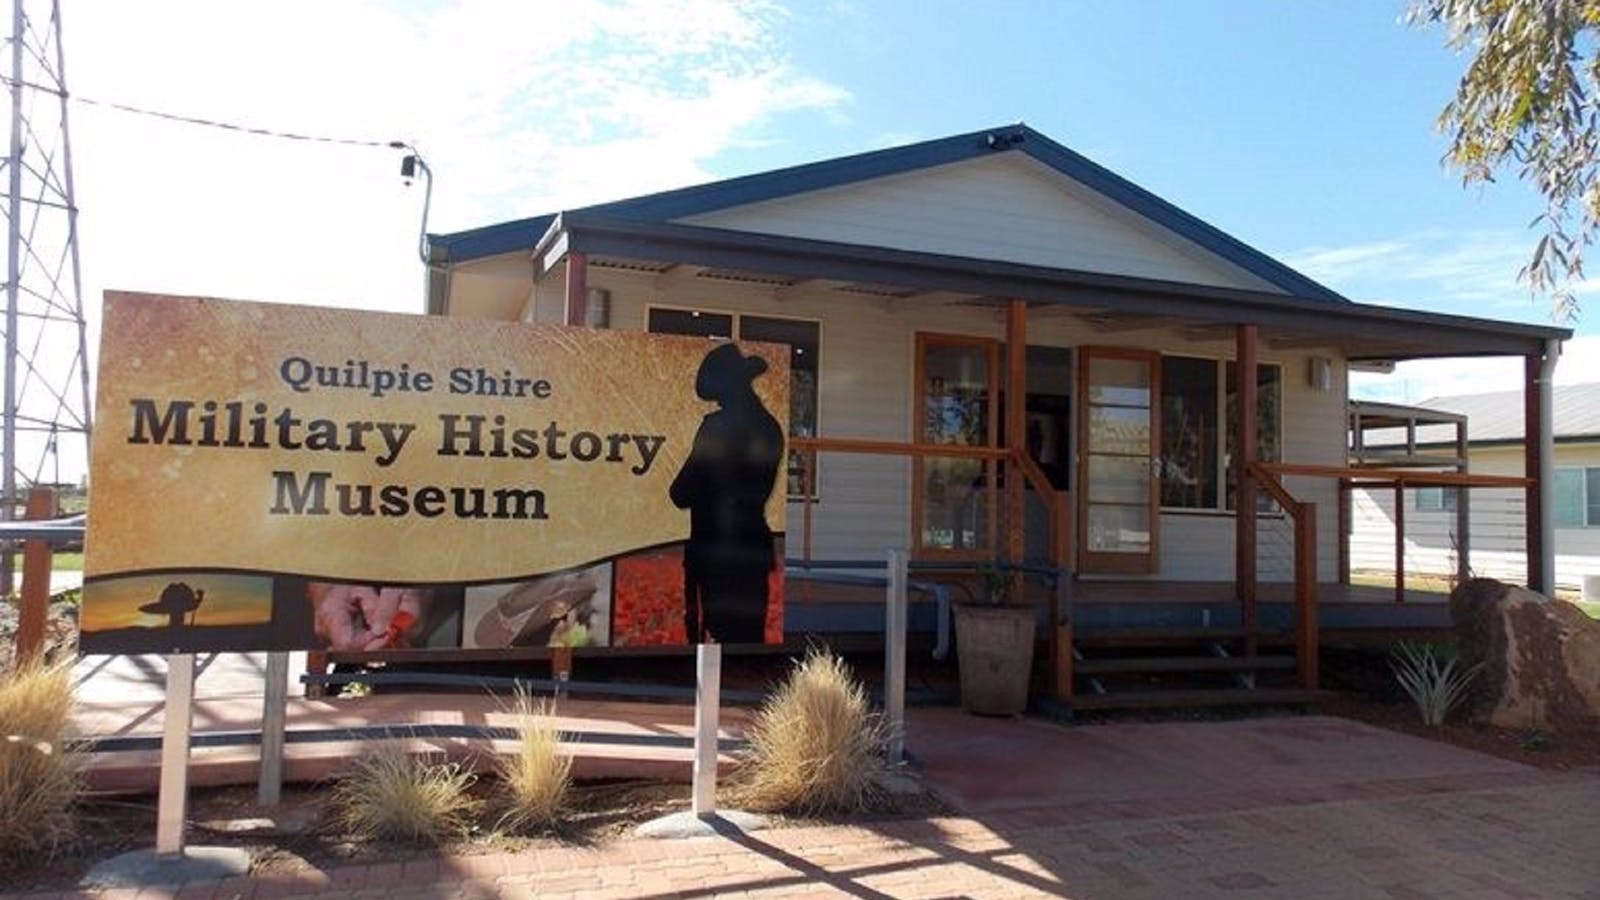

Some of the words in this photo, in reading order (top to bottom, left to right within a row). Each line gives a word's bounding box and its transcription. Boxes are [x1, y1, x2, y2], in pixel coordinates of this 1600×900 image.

[280, 357, 434, 397] Quilpie
[449, 367, 552, 399] Shire
[127, 398, 416, 466] Military
[437, 413, 667, 476] History
[269, 470, 549, 520] Museum
